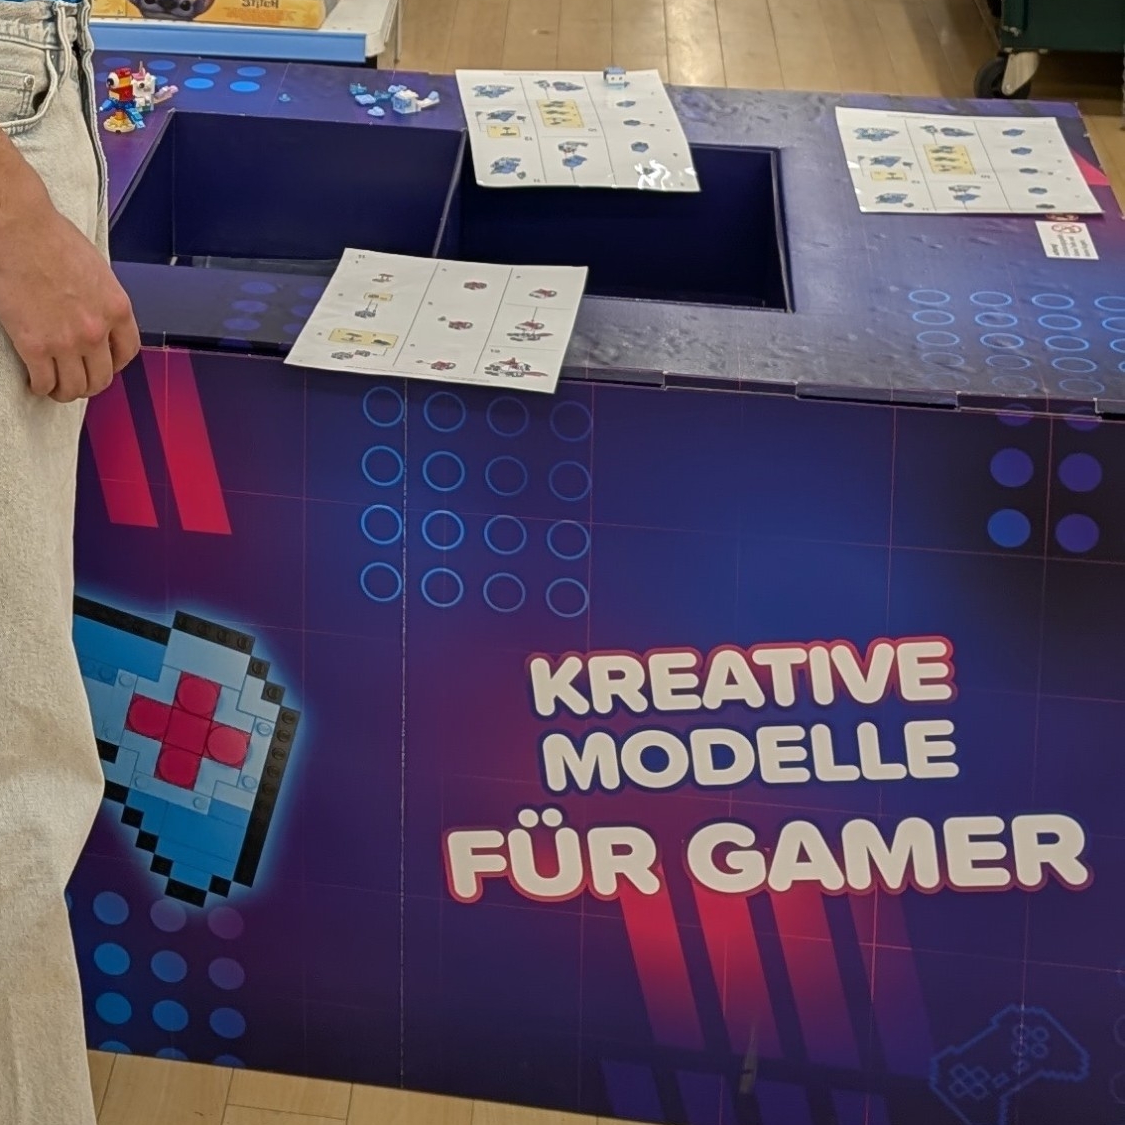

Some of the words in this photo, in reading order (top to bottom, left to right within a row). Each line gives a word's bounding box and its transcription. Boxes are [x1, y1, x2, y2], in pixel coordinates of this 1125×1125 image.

[528, 640, 955, 717] KREATIVE
[541, 719, 960, 792] MODELLE
[446, 806, 662, 900] FÜR
[686, 813, 1090, 894] GAMER
